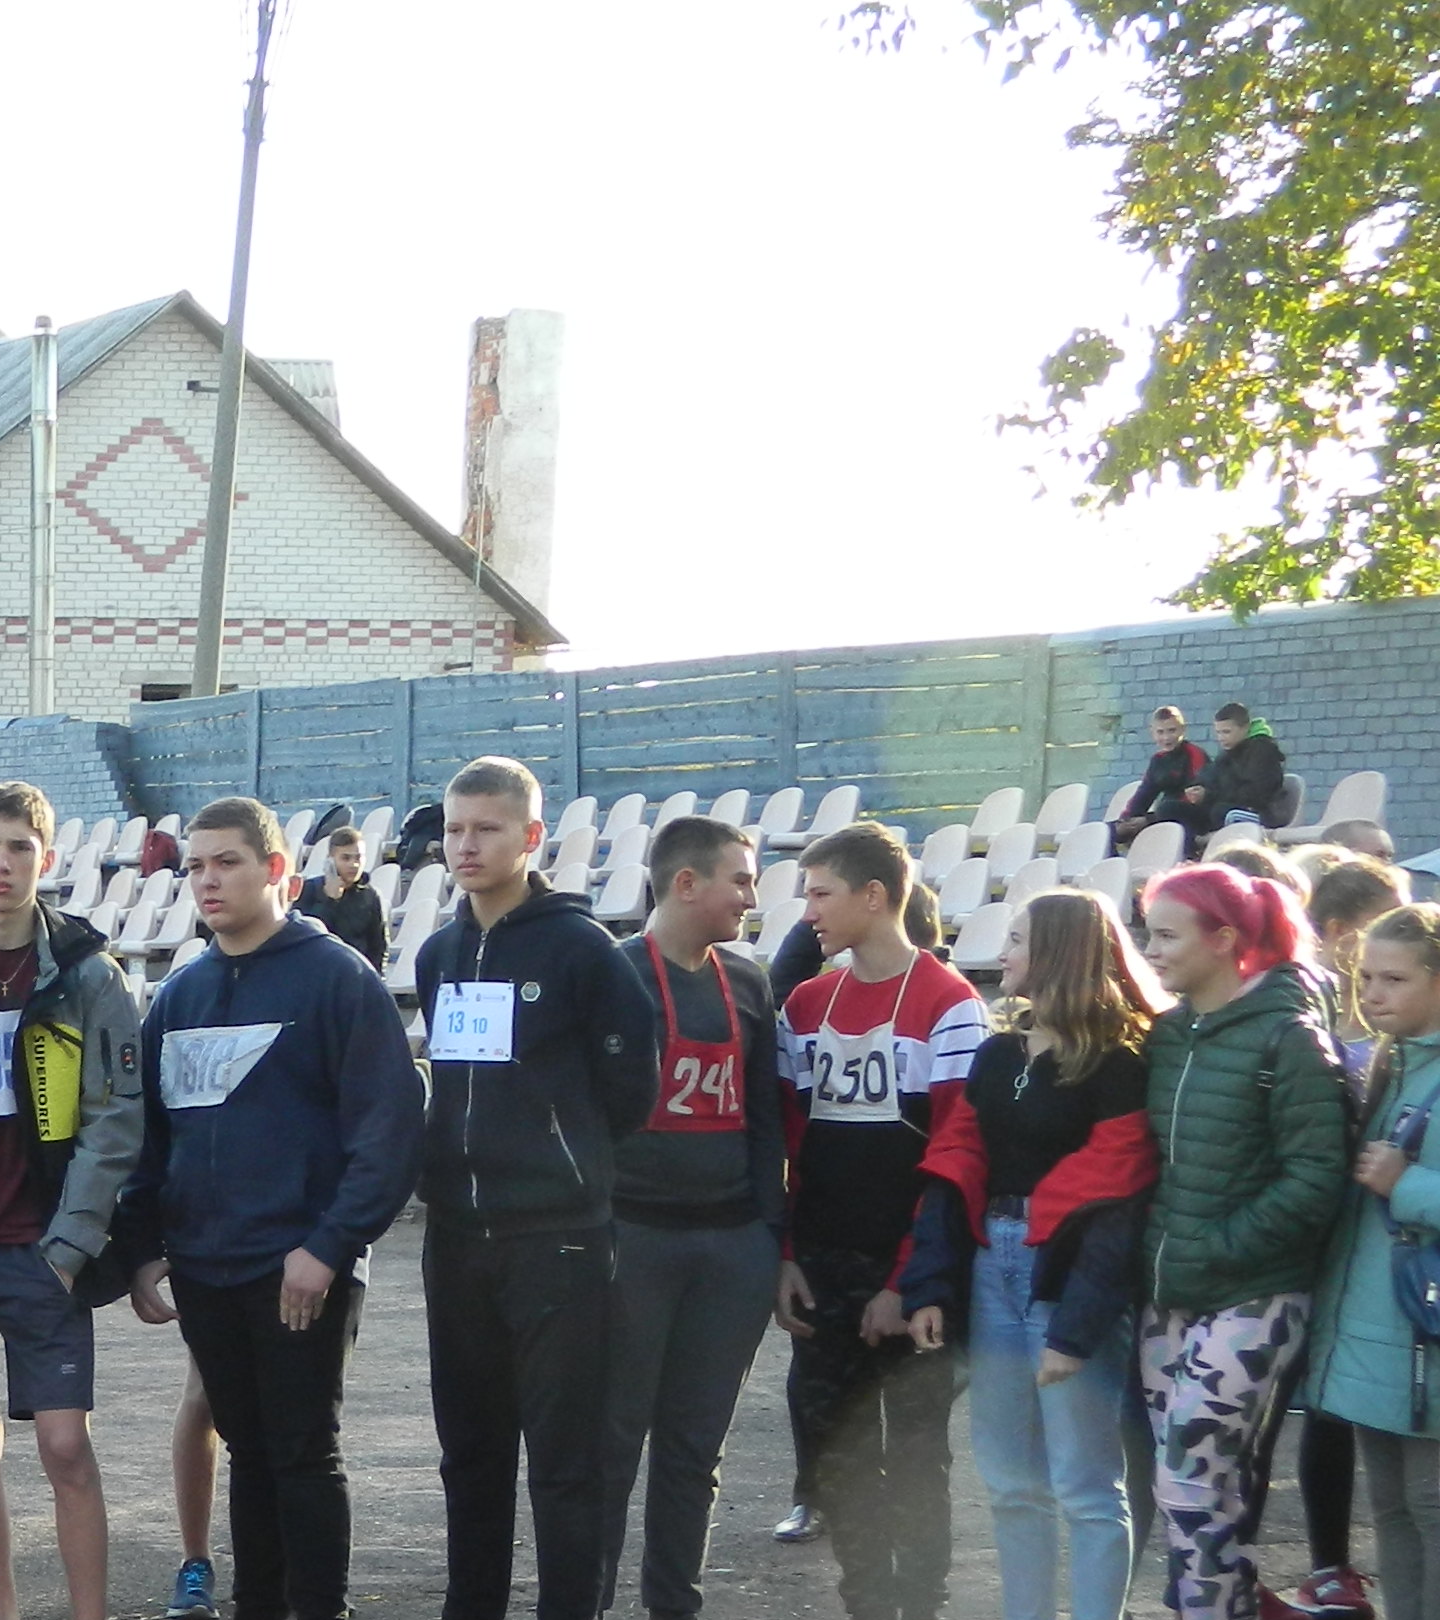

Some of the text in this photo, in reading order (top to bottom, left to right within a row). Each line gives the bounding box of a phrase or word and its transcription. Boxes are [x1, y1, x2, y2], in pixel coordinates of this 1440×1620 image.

[448, 1011, 487, 1034] 13 10
[34, 1035, 51, 1137] SUPERIORES
[667, 1055, 739, 1114] 241
[818, 1051, 888, 1103] 250
